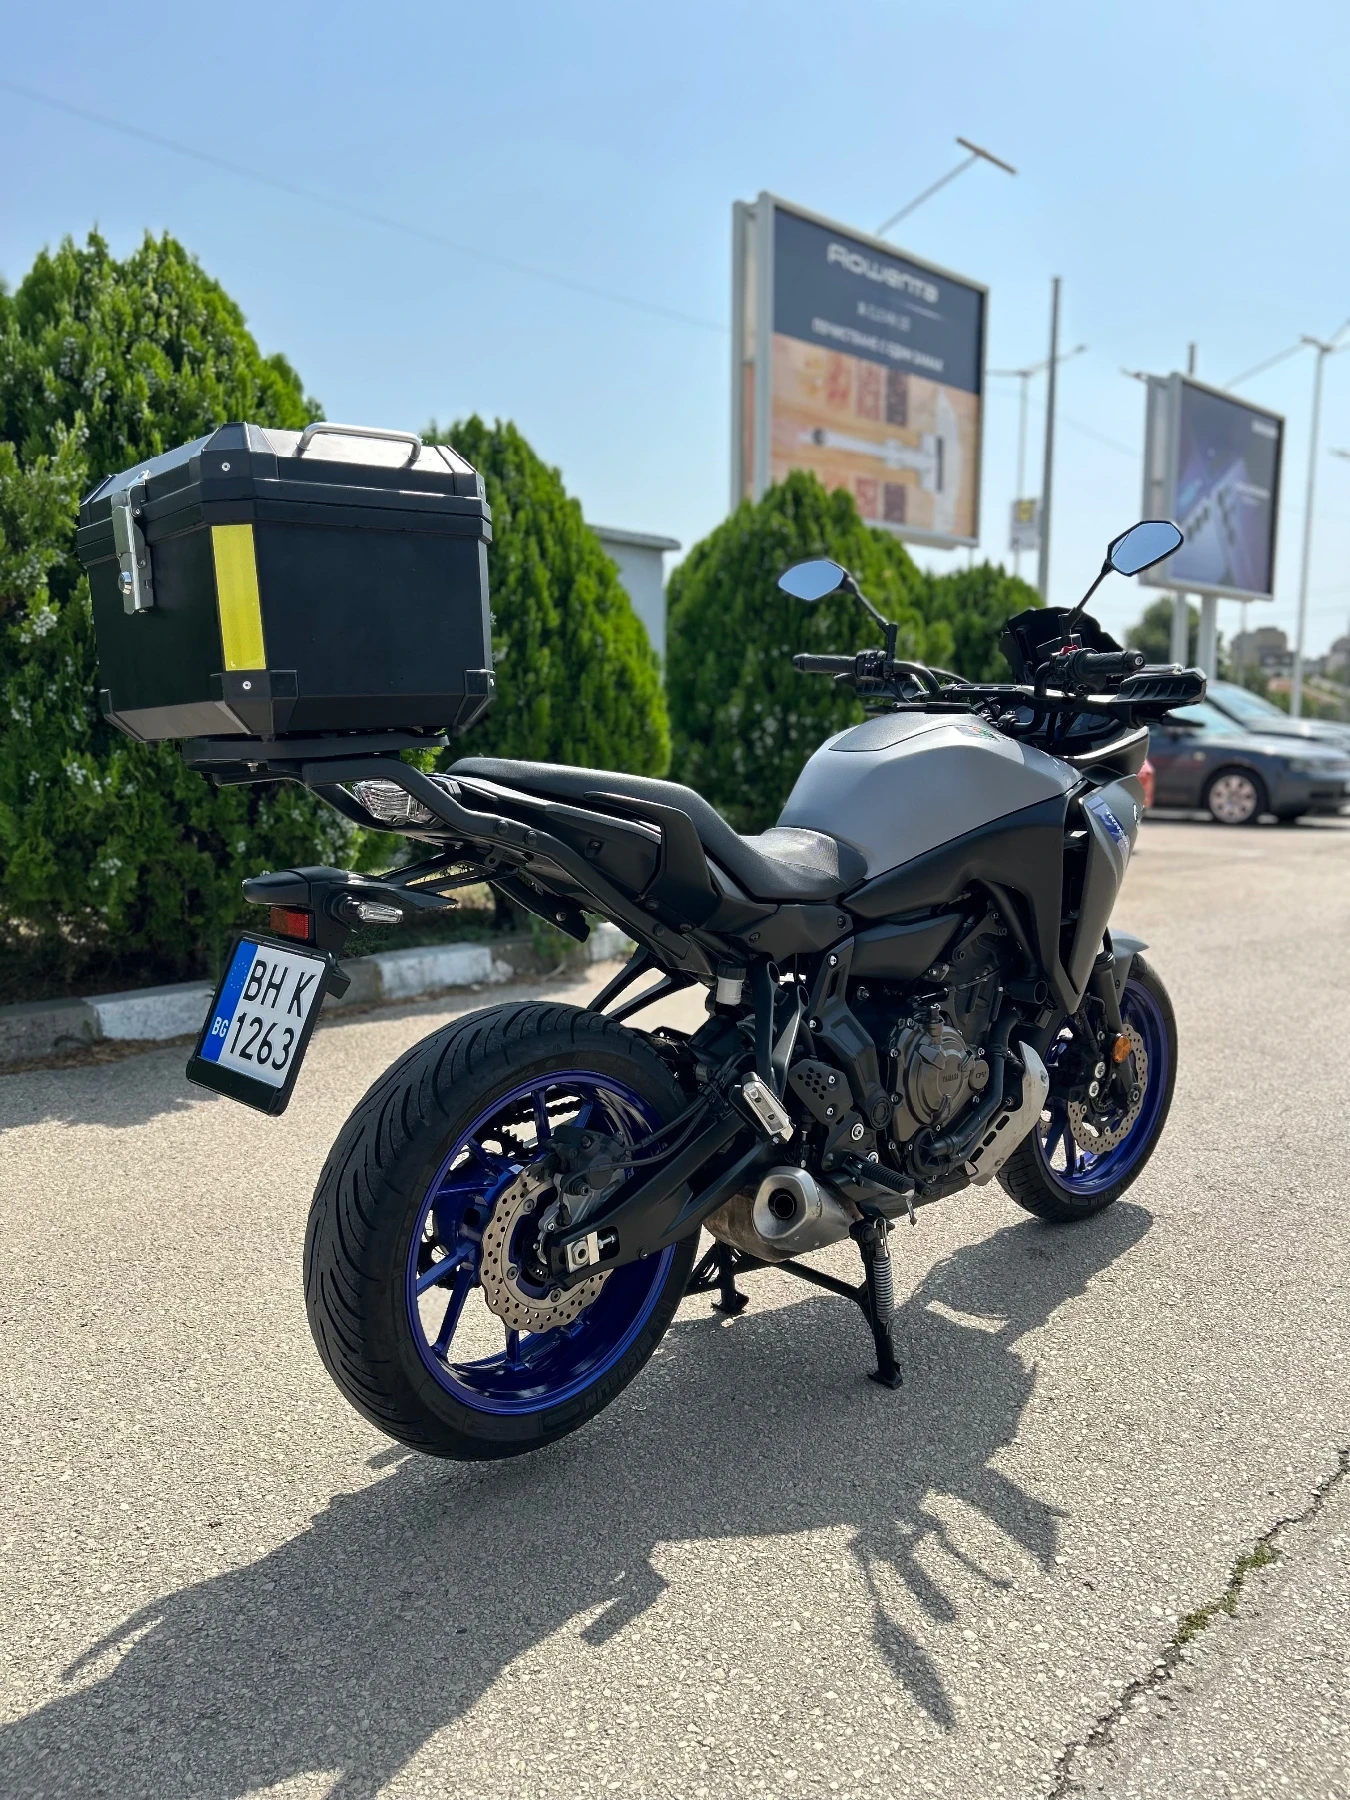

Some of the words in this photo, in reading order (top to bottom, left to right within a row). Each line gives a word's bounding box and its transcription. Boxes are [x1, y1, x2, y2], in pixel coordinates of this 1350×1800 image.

[242, 959, 289, 1009] BH
[287, 971, 316, 1018] K
[211, 1016, 229, 1038] BG
[229, 1011, 295, 1071] 1263
